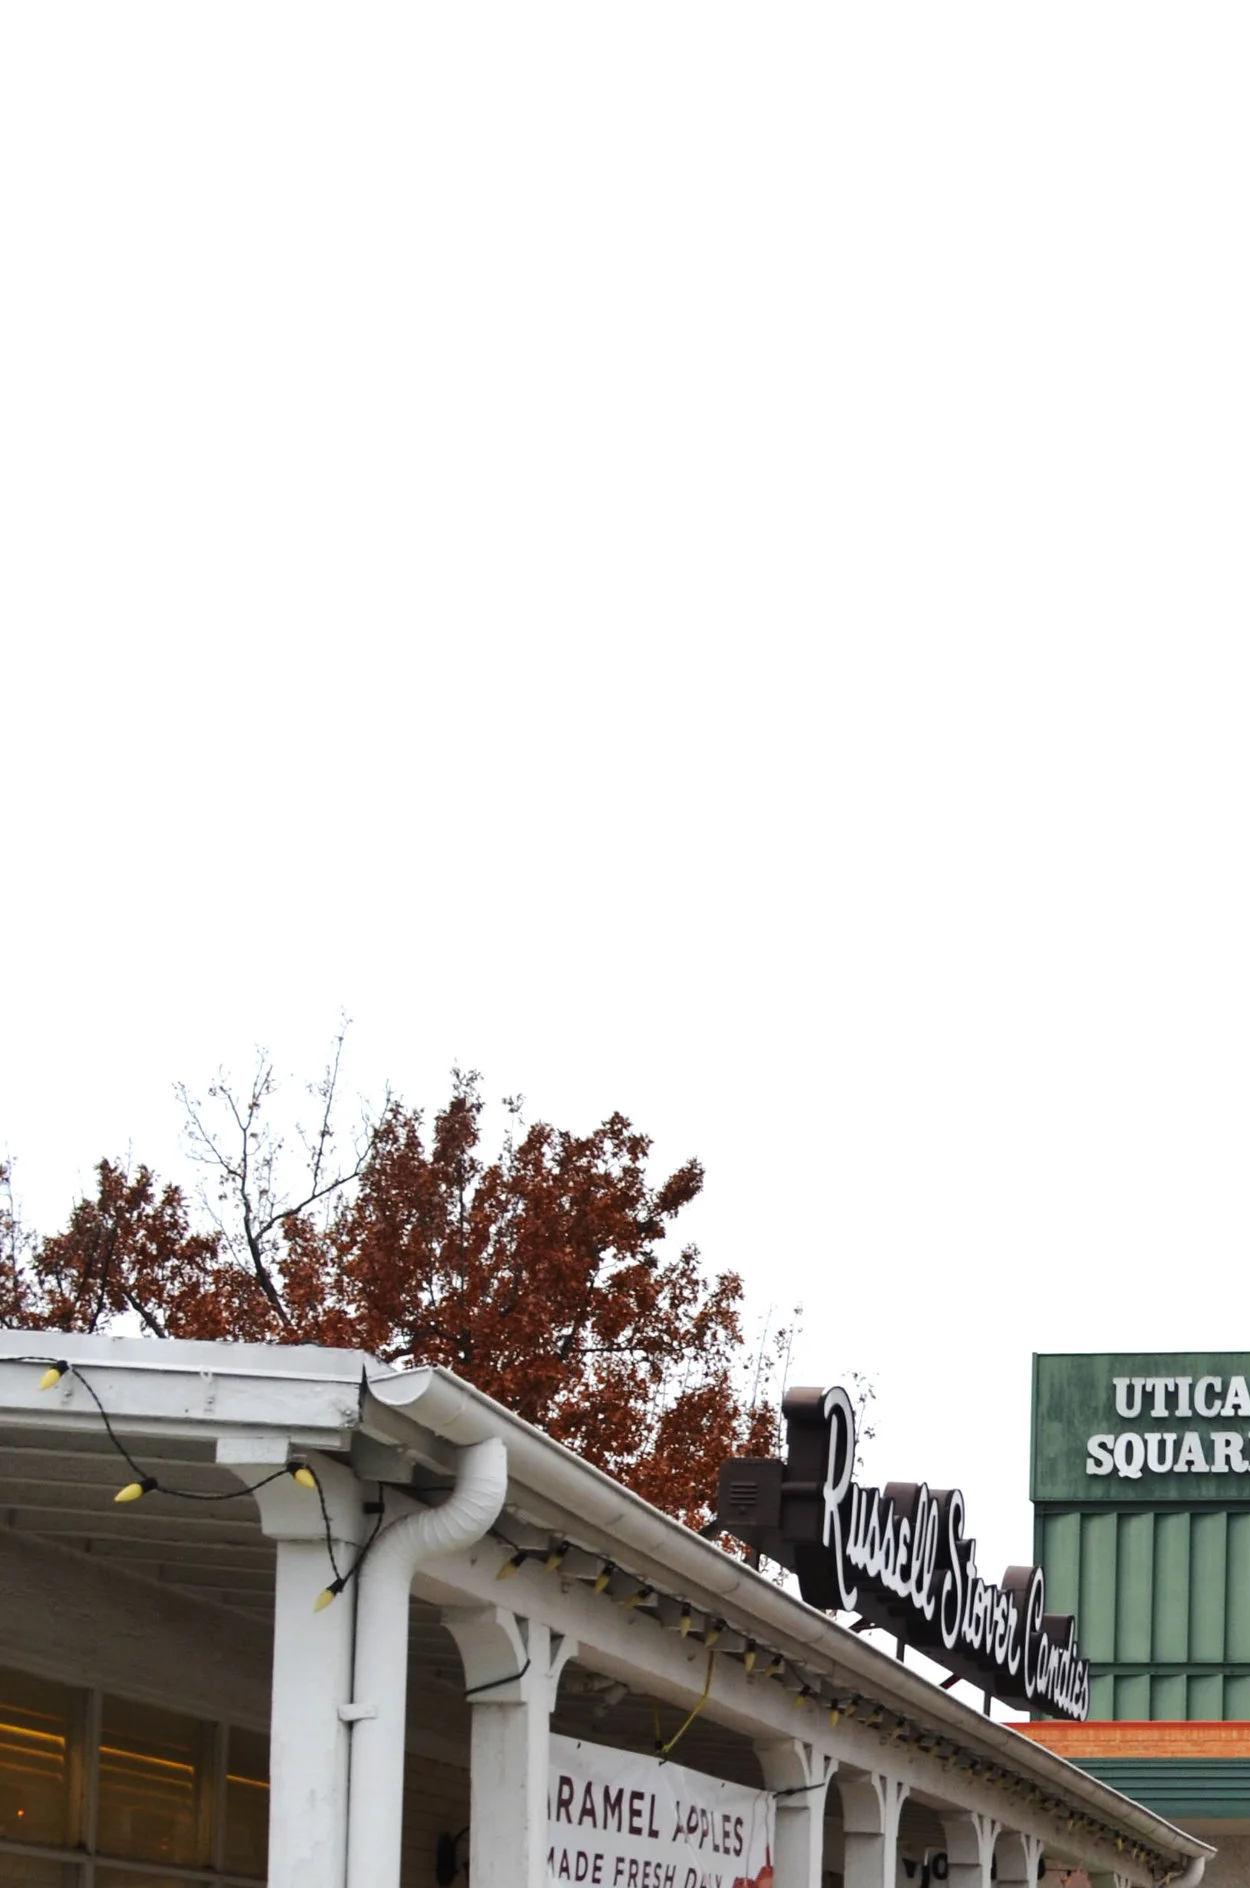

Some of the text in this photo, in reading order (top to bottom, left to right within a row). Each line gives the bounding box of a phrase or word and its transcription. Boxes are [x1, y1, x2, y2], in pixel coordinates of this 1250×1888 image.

[823, 1387, 1089, 1721] Russell Stover Candies
[548, 1775, 743, 1857] RAMEL APPLES
